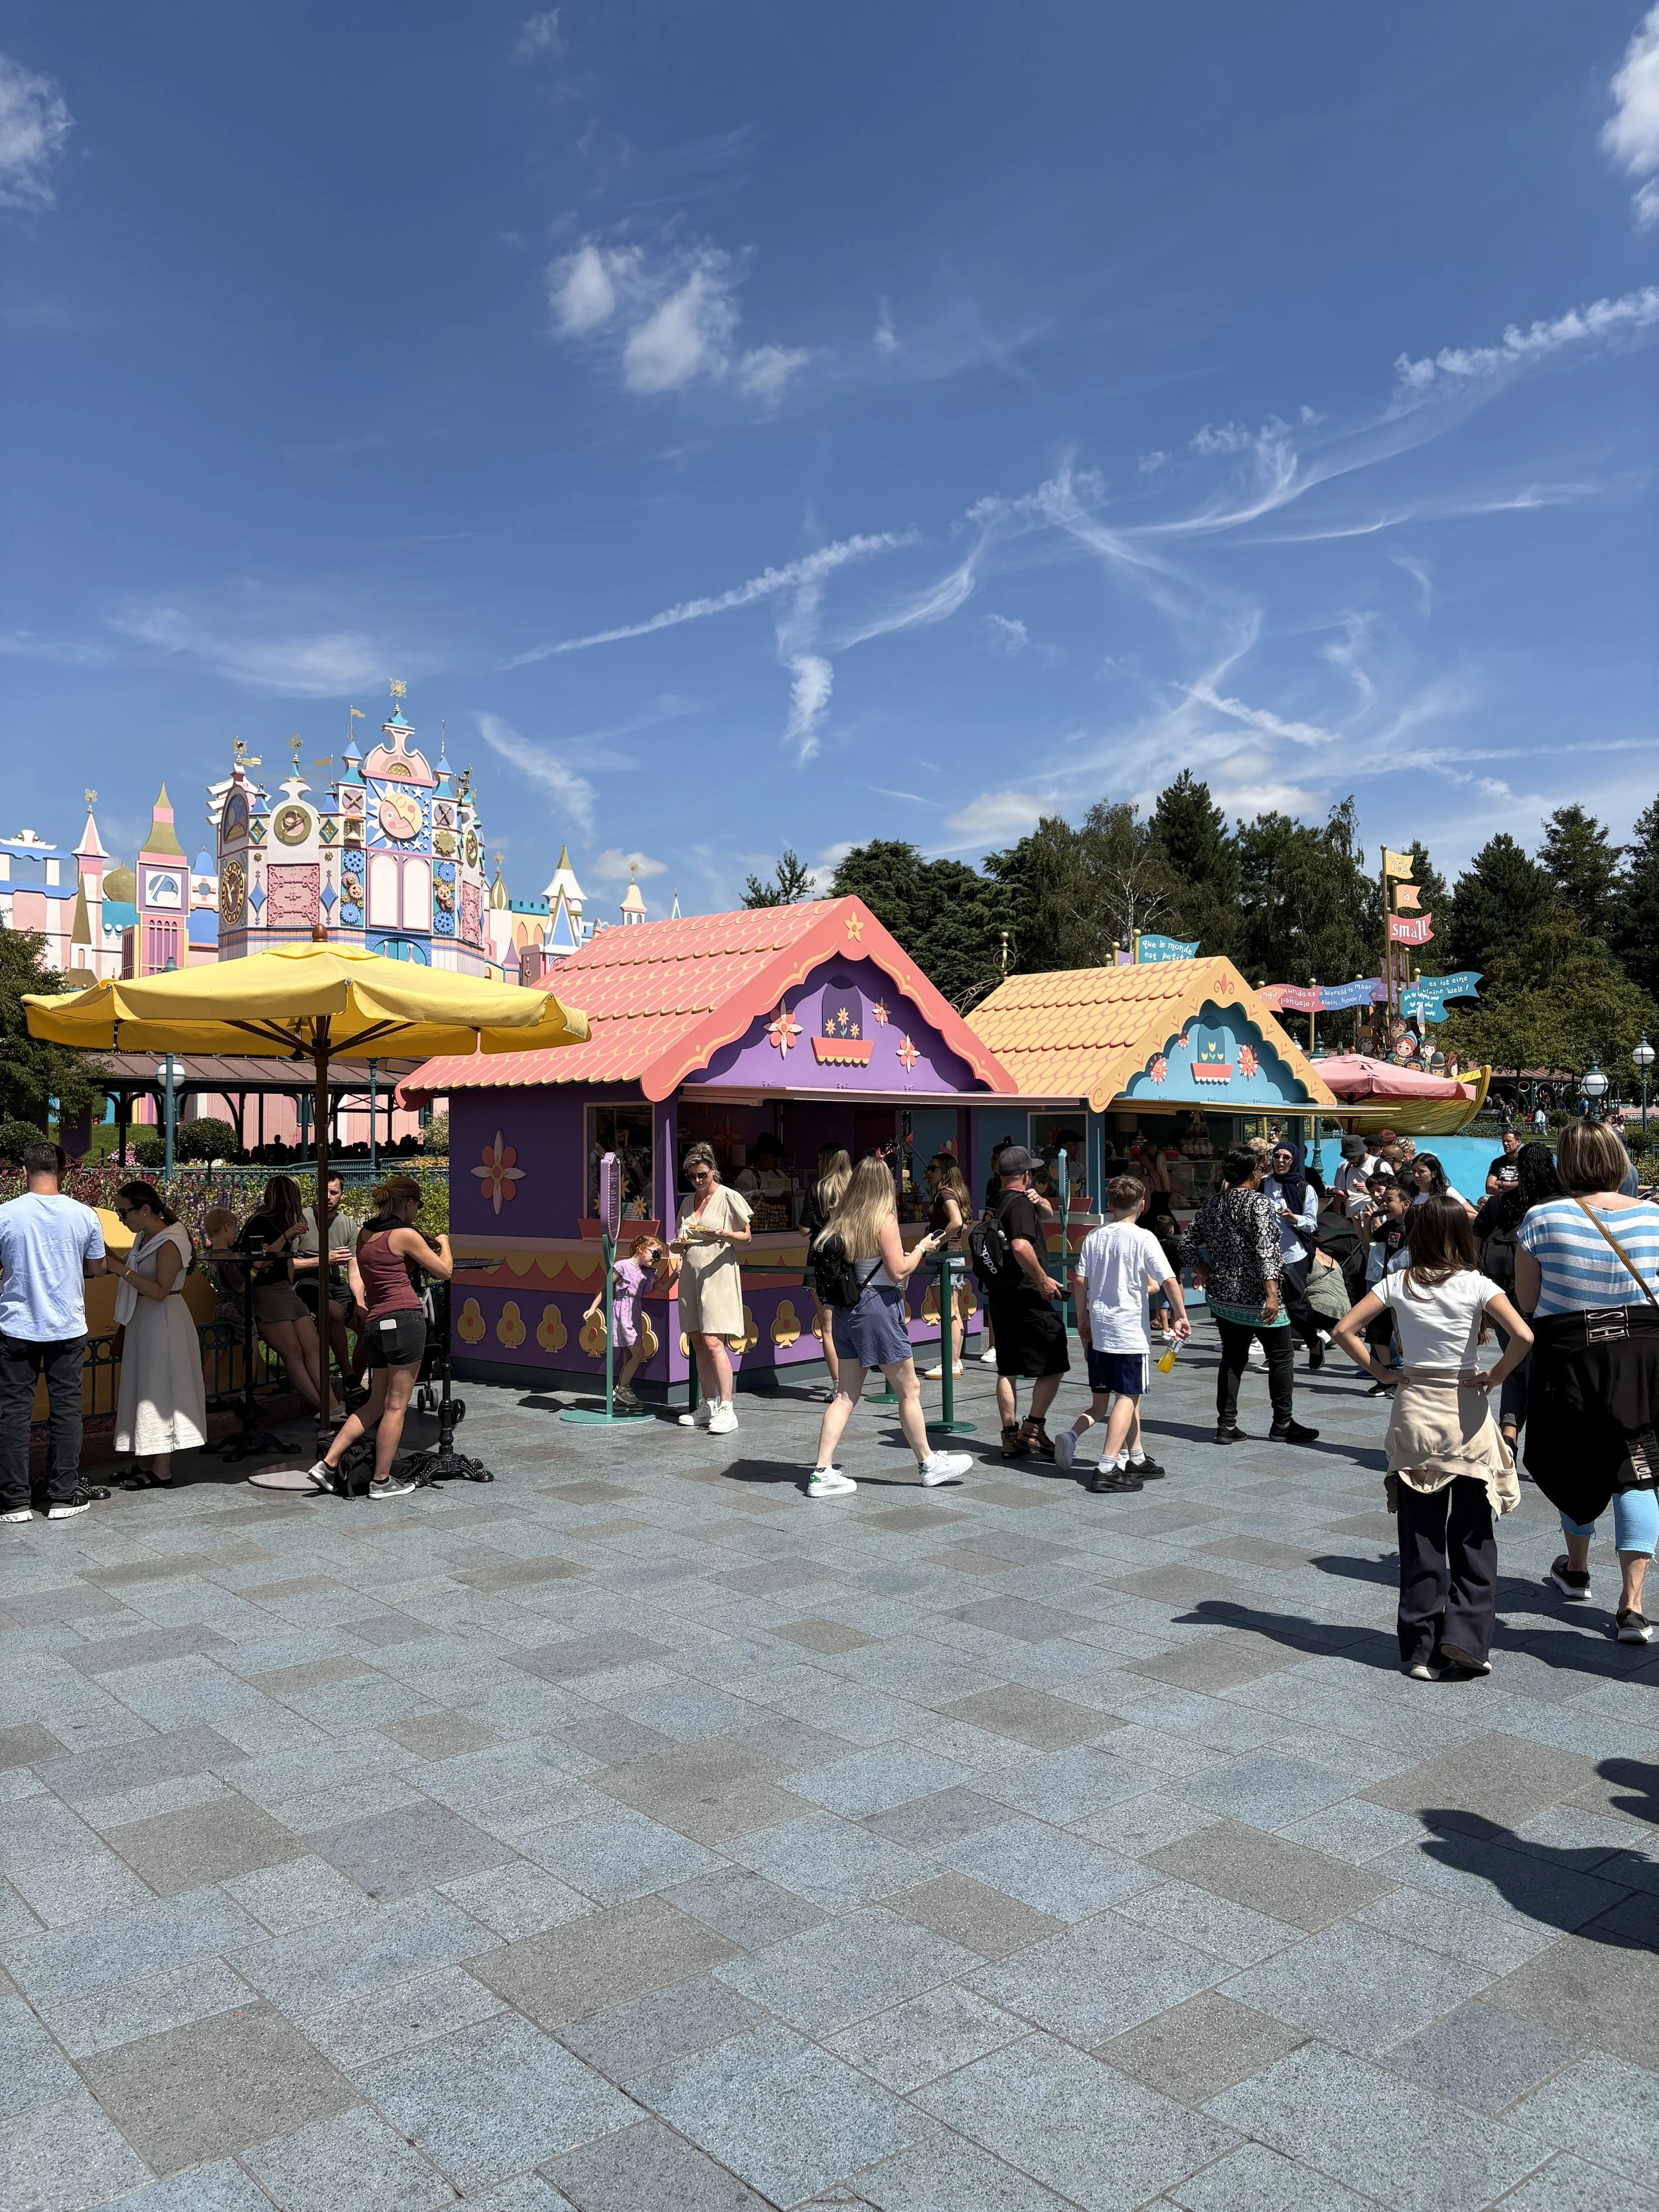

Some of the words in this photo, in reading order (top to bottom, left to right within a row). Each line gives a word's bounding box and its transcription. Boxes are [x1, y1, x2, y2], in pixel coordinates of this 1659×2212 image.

[1404, 889, 1411, 902] a
[1392, 920, 1427, 941] small
[1142, 940, 1157, 950] que
[1159, 940, 1165, 948] le
[1168, 942, 1192, 955] monde
[1144, 951, 1157, 960] est
